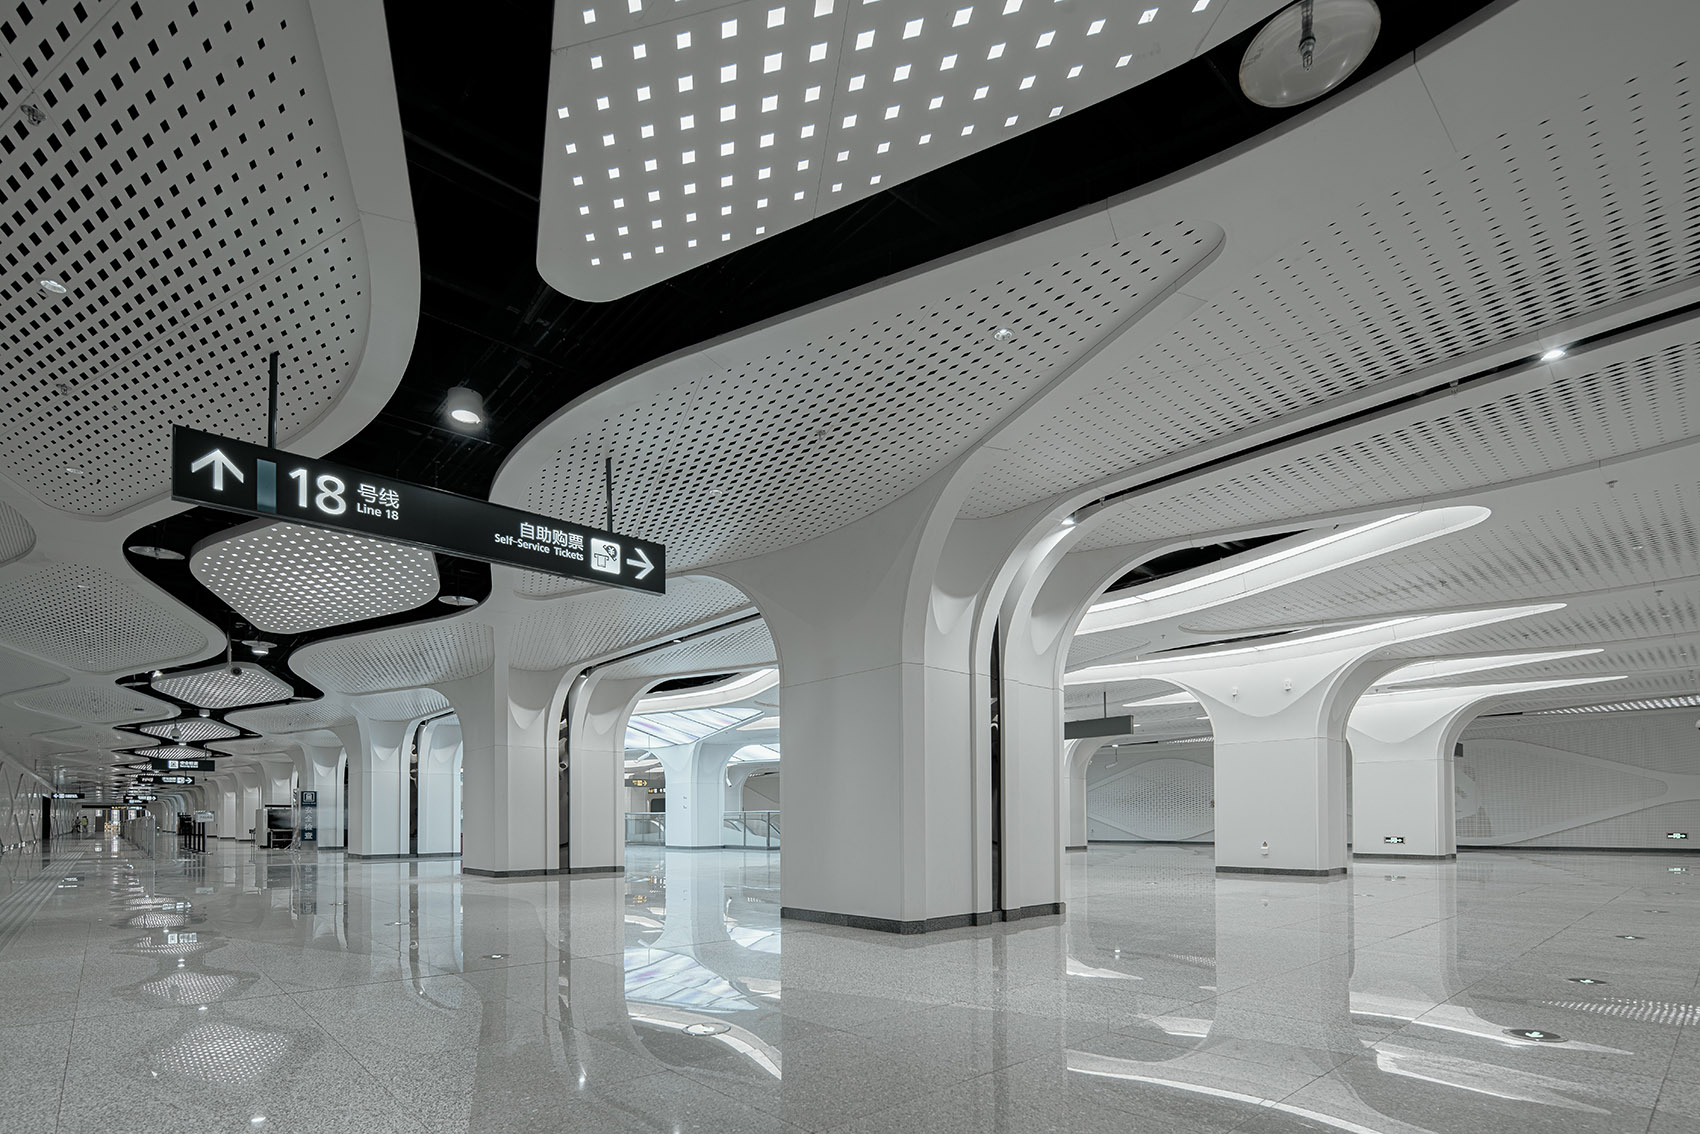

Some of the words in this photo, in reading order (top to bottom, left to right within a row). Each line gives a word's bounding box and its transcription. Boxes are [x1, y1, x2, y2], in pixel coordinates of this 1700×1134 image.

[288, 469, 347, 514] 18
[357, 483, 399, 509] 号线
[357, 503, 382, 517] Line
[385, 509, 399, 521] 18
[494, 533, 550, 554] Self-Service
[554, 547, 584, 561] Tickets
[520, 522, 584, 551] 自助购票
